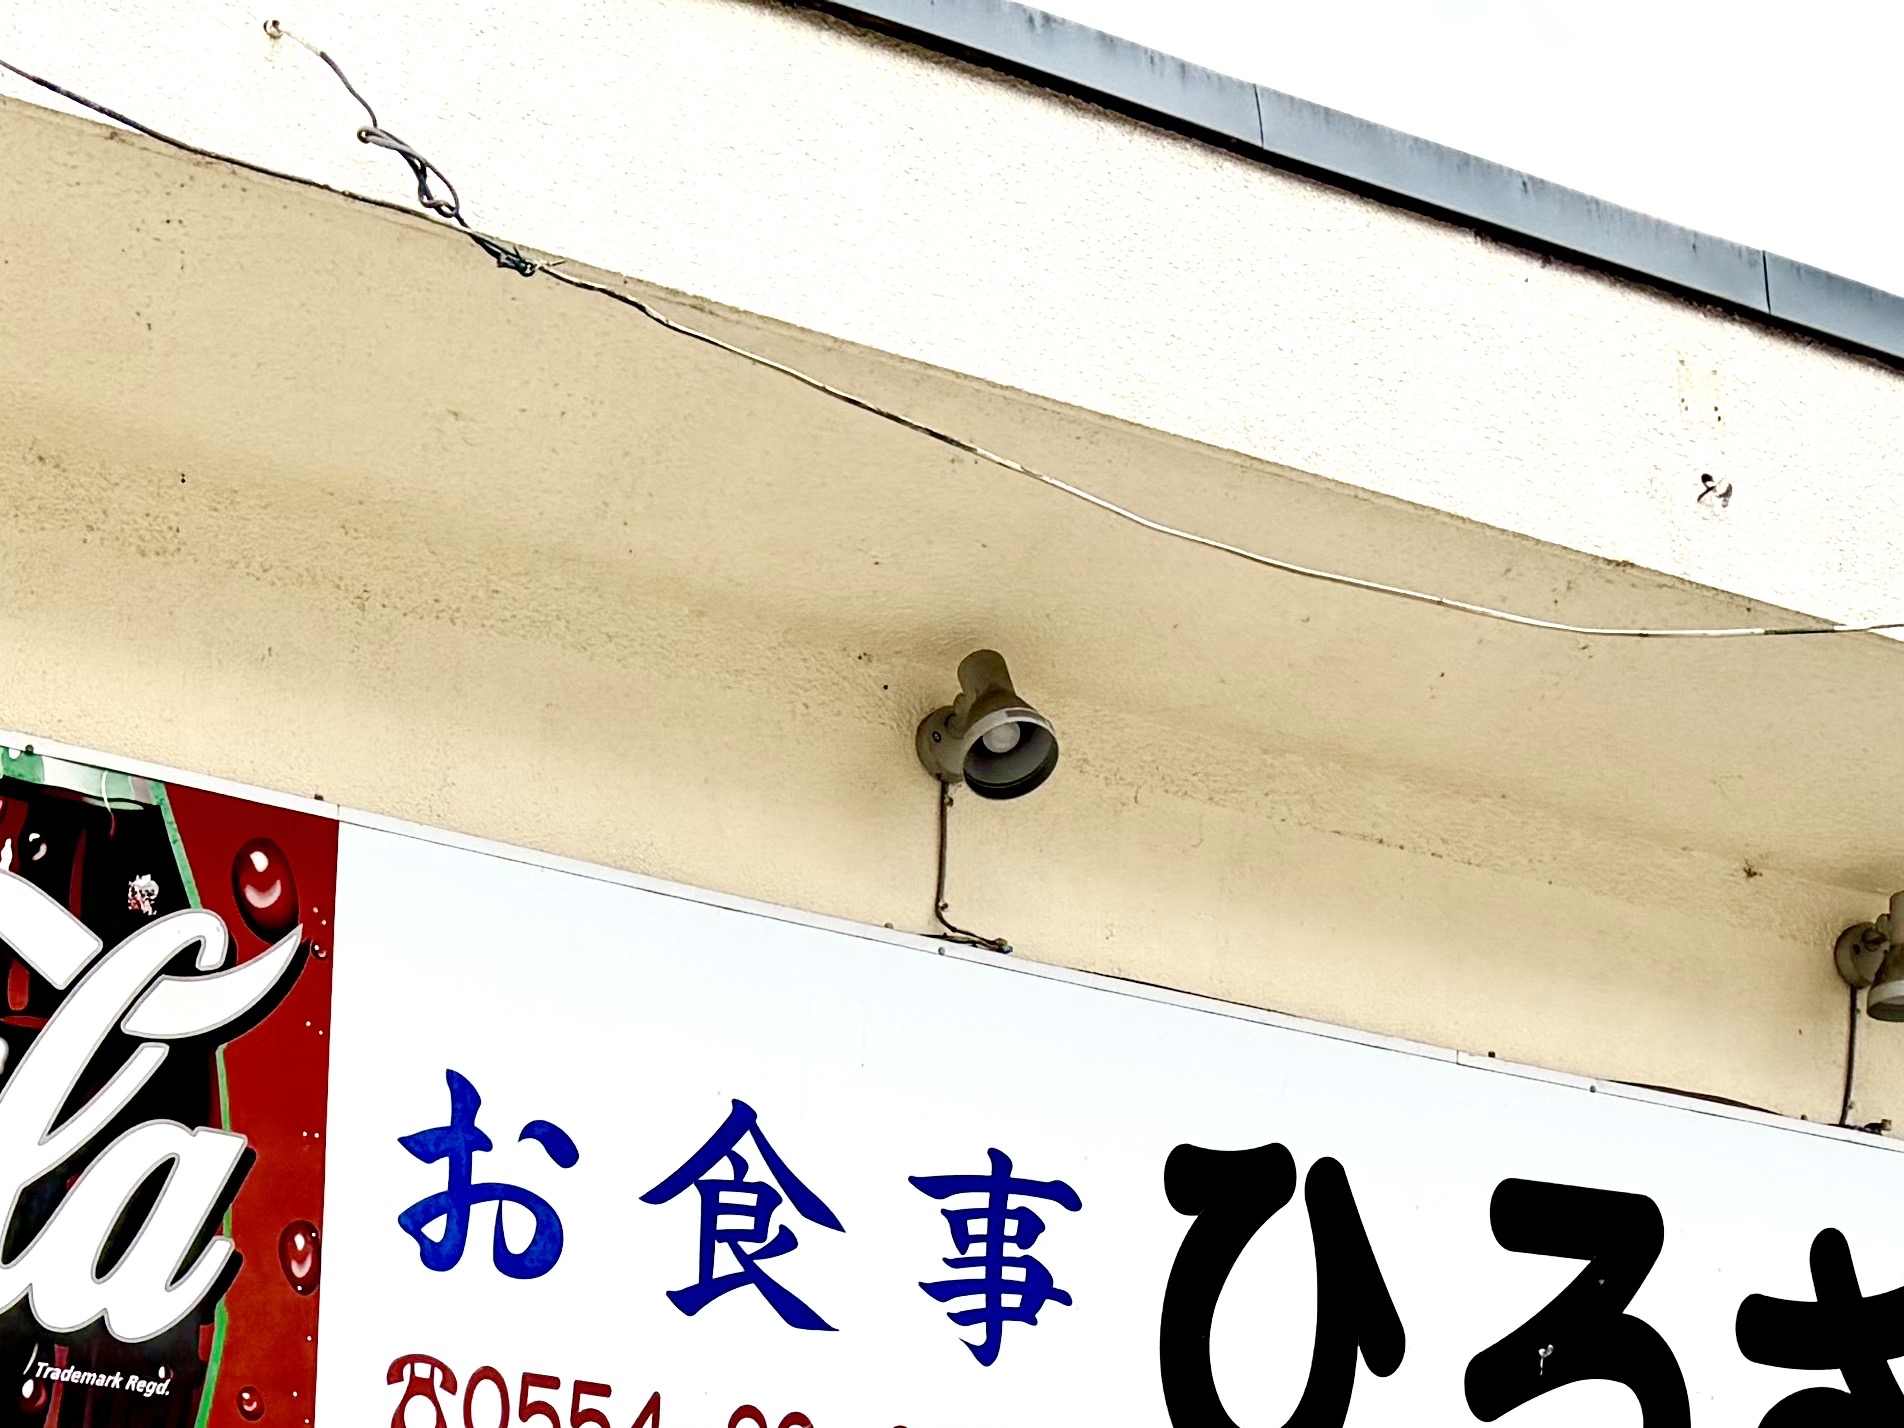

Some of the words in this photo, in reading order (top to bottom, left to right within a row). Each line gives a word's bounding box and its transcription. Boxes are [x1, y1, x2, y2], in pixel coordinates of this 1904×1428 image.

[397, 1068, 1082, 1366] お食事
[35, 1360, 117, 1387] Trademark
[121, 1370, 173, 1397] Regd.
